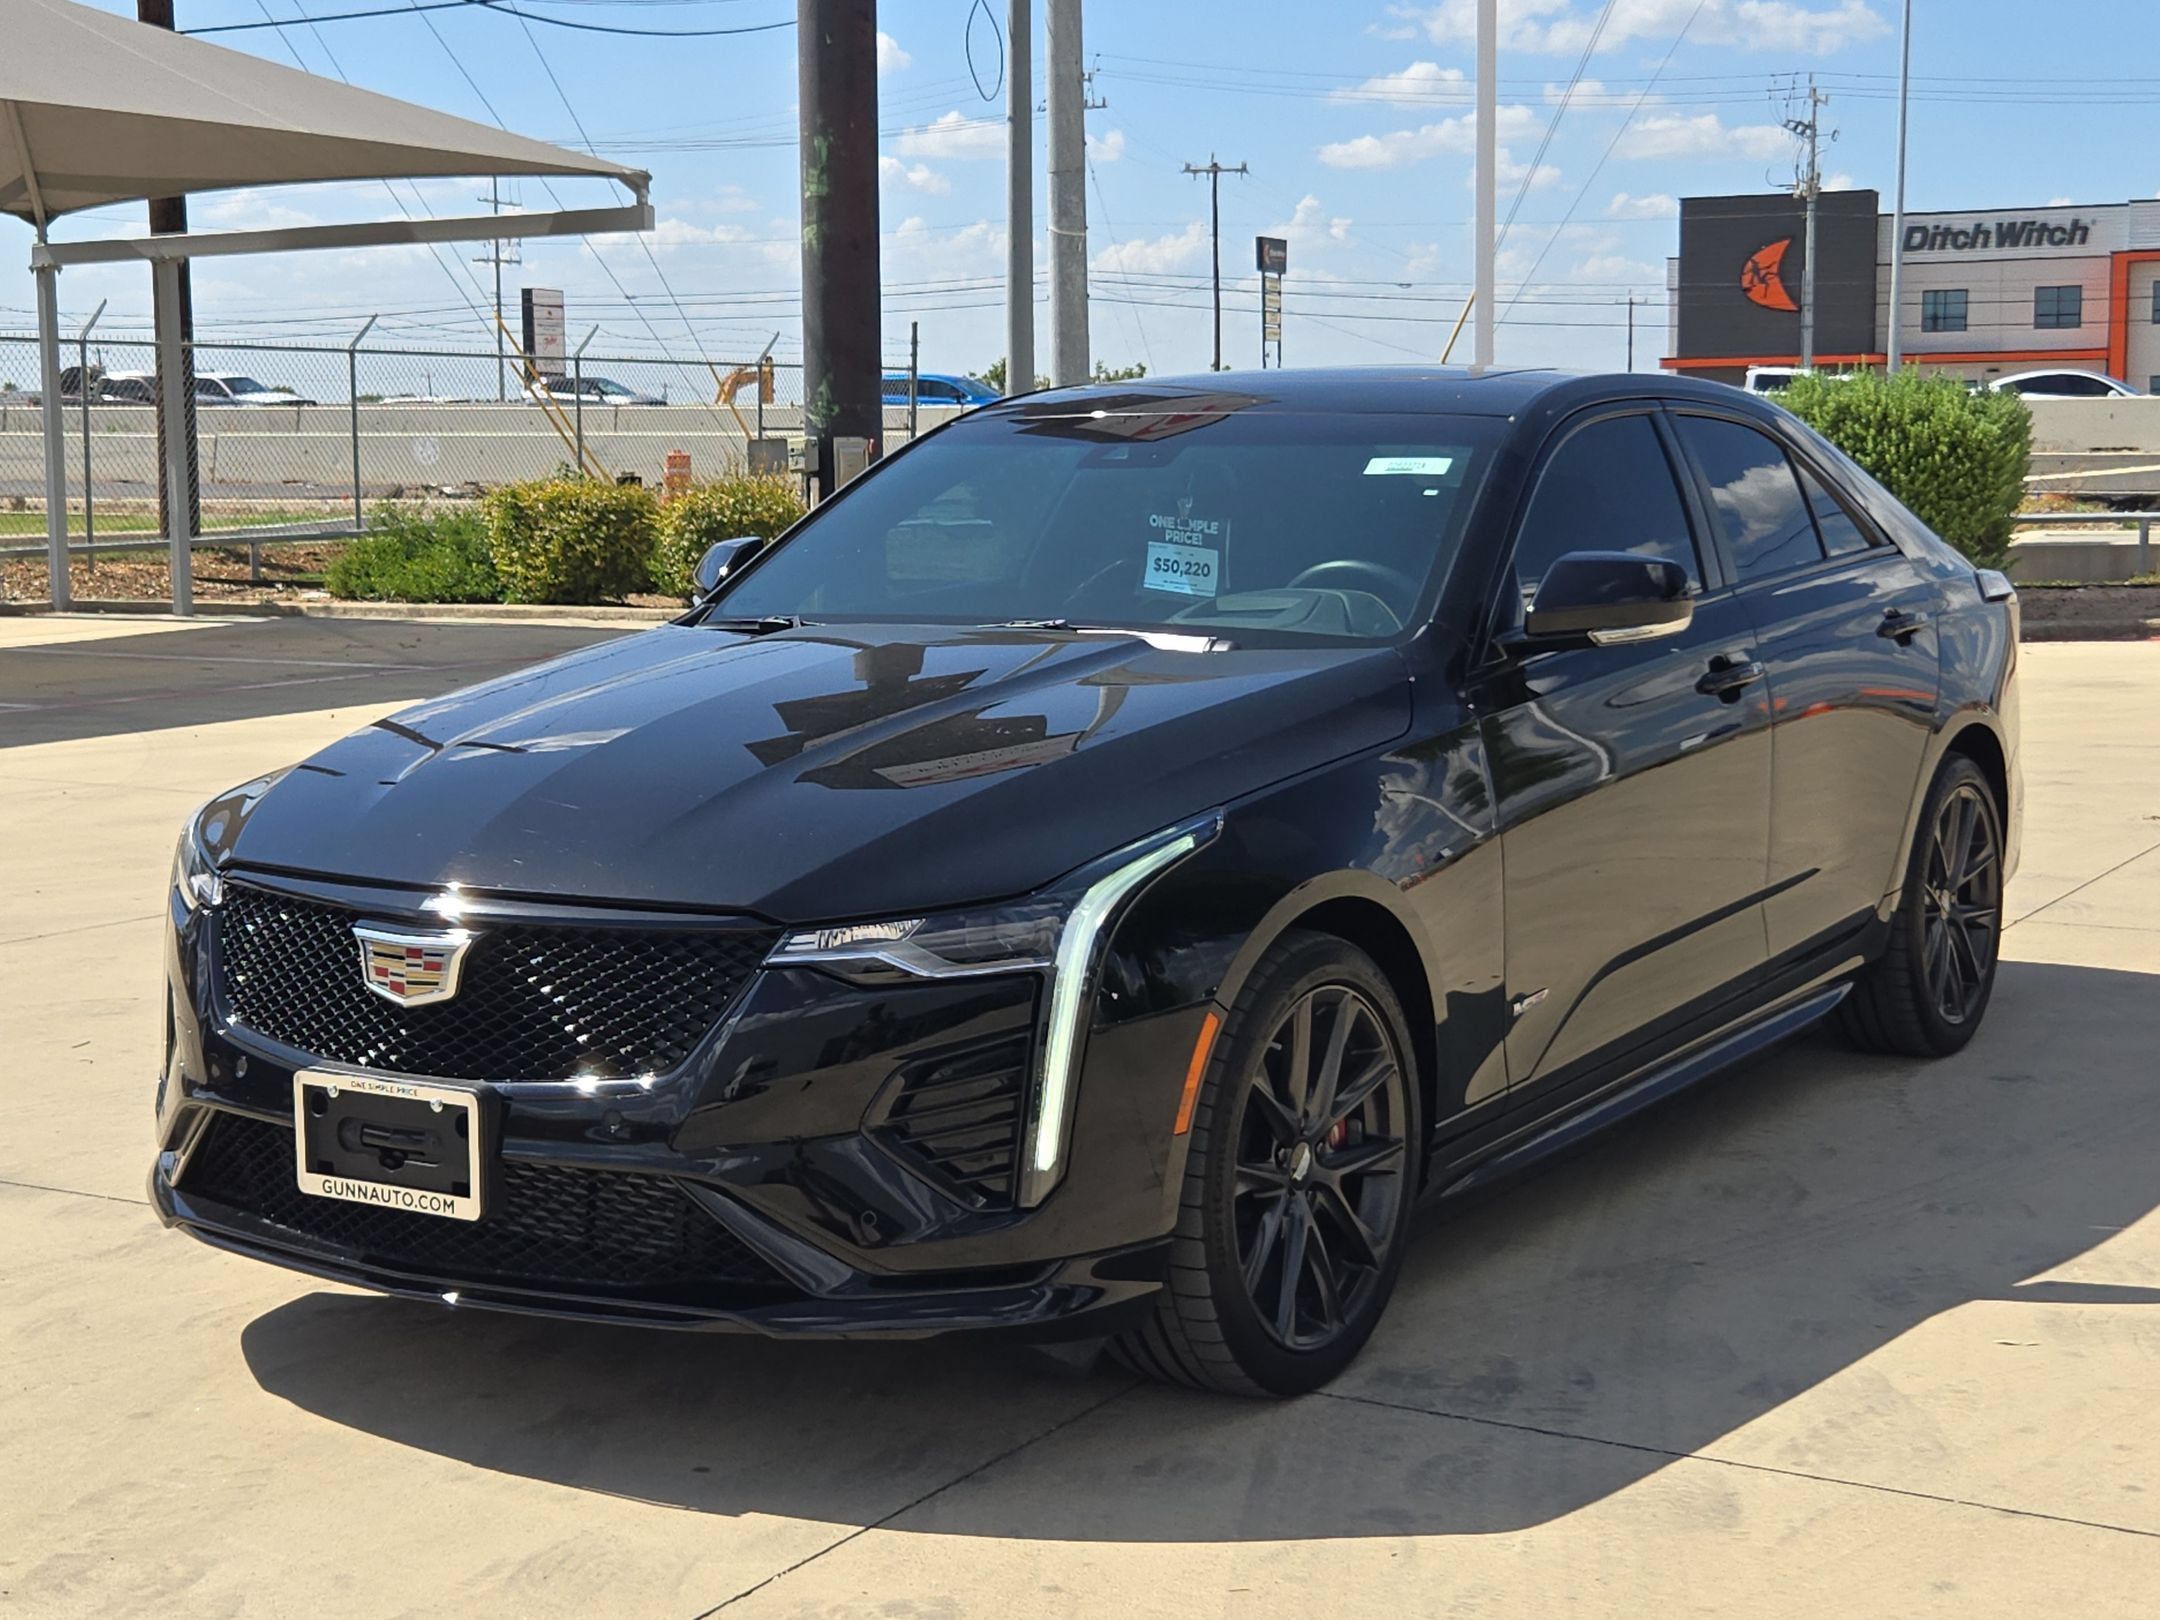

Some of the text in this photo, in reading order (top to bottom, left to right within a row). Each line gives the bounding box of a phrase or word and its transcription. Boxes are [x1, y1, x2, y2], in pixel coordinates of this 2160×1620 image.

[1903, 218, 2090, 251] Ditch Witch
[1149, 514, 1175, 529] ONE
[1153, 557, 1211, 578] $50,220
[350, 1080, 418, 1097] ONE SIMPLE PRICE
[322, 1179, 455, 1214] GUNNAUTO.COM
